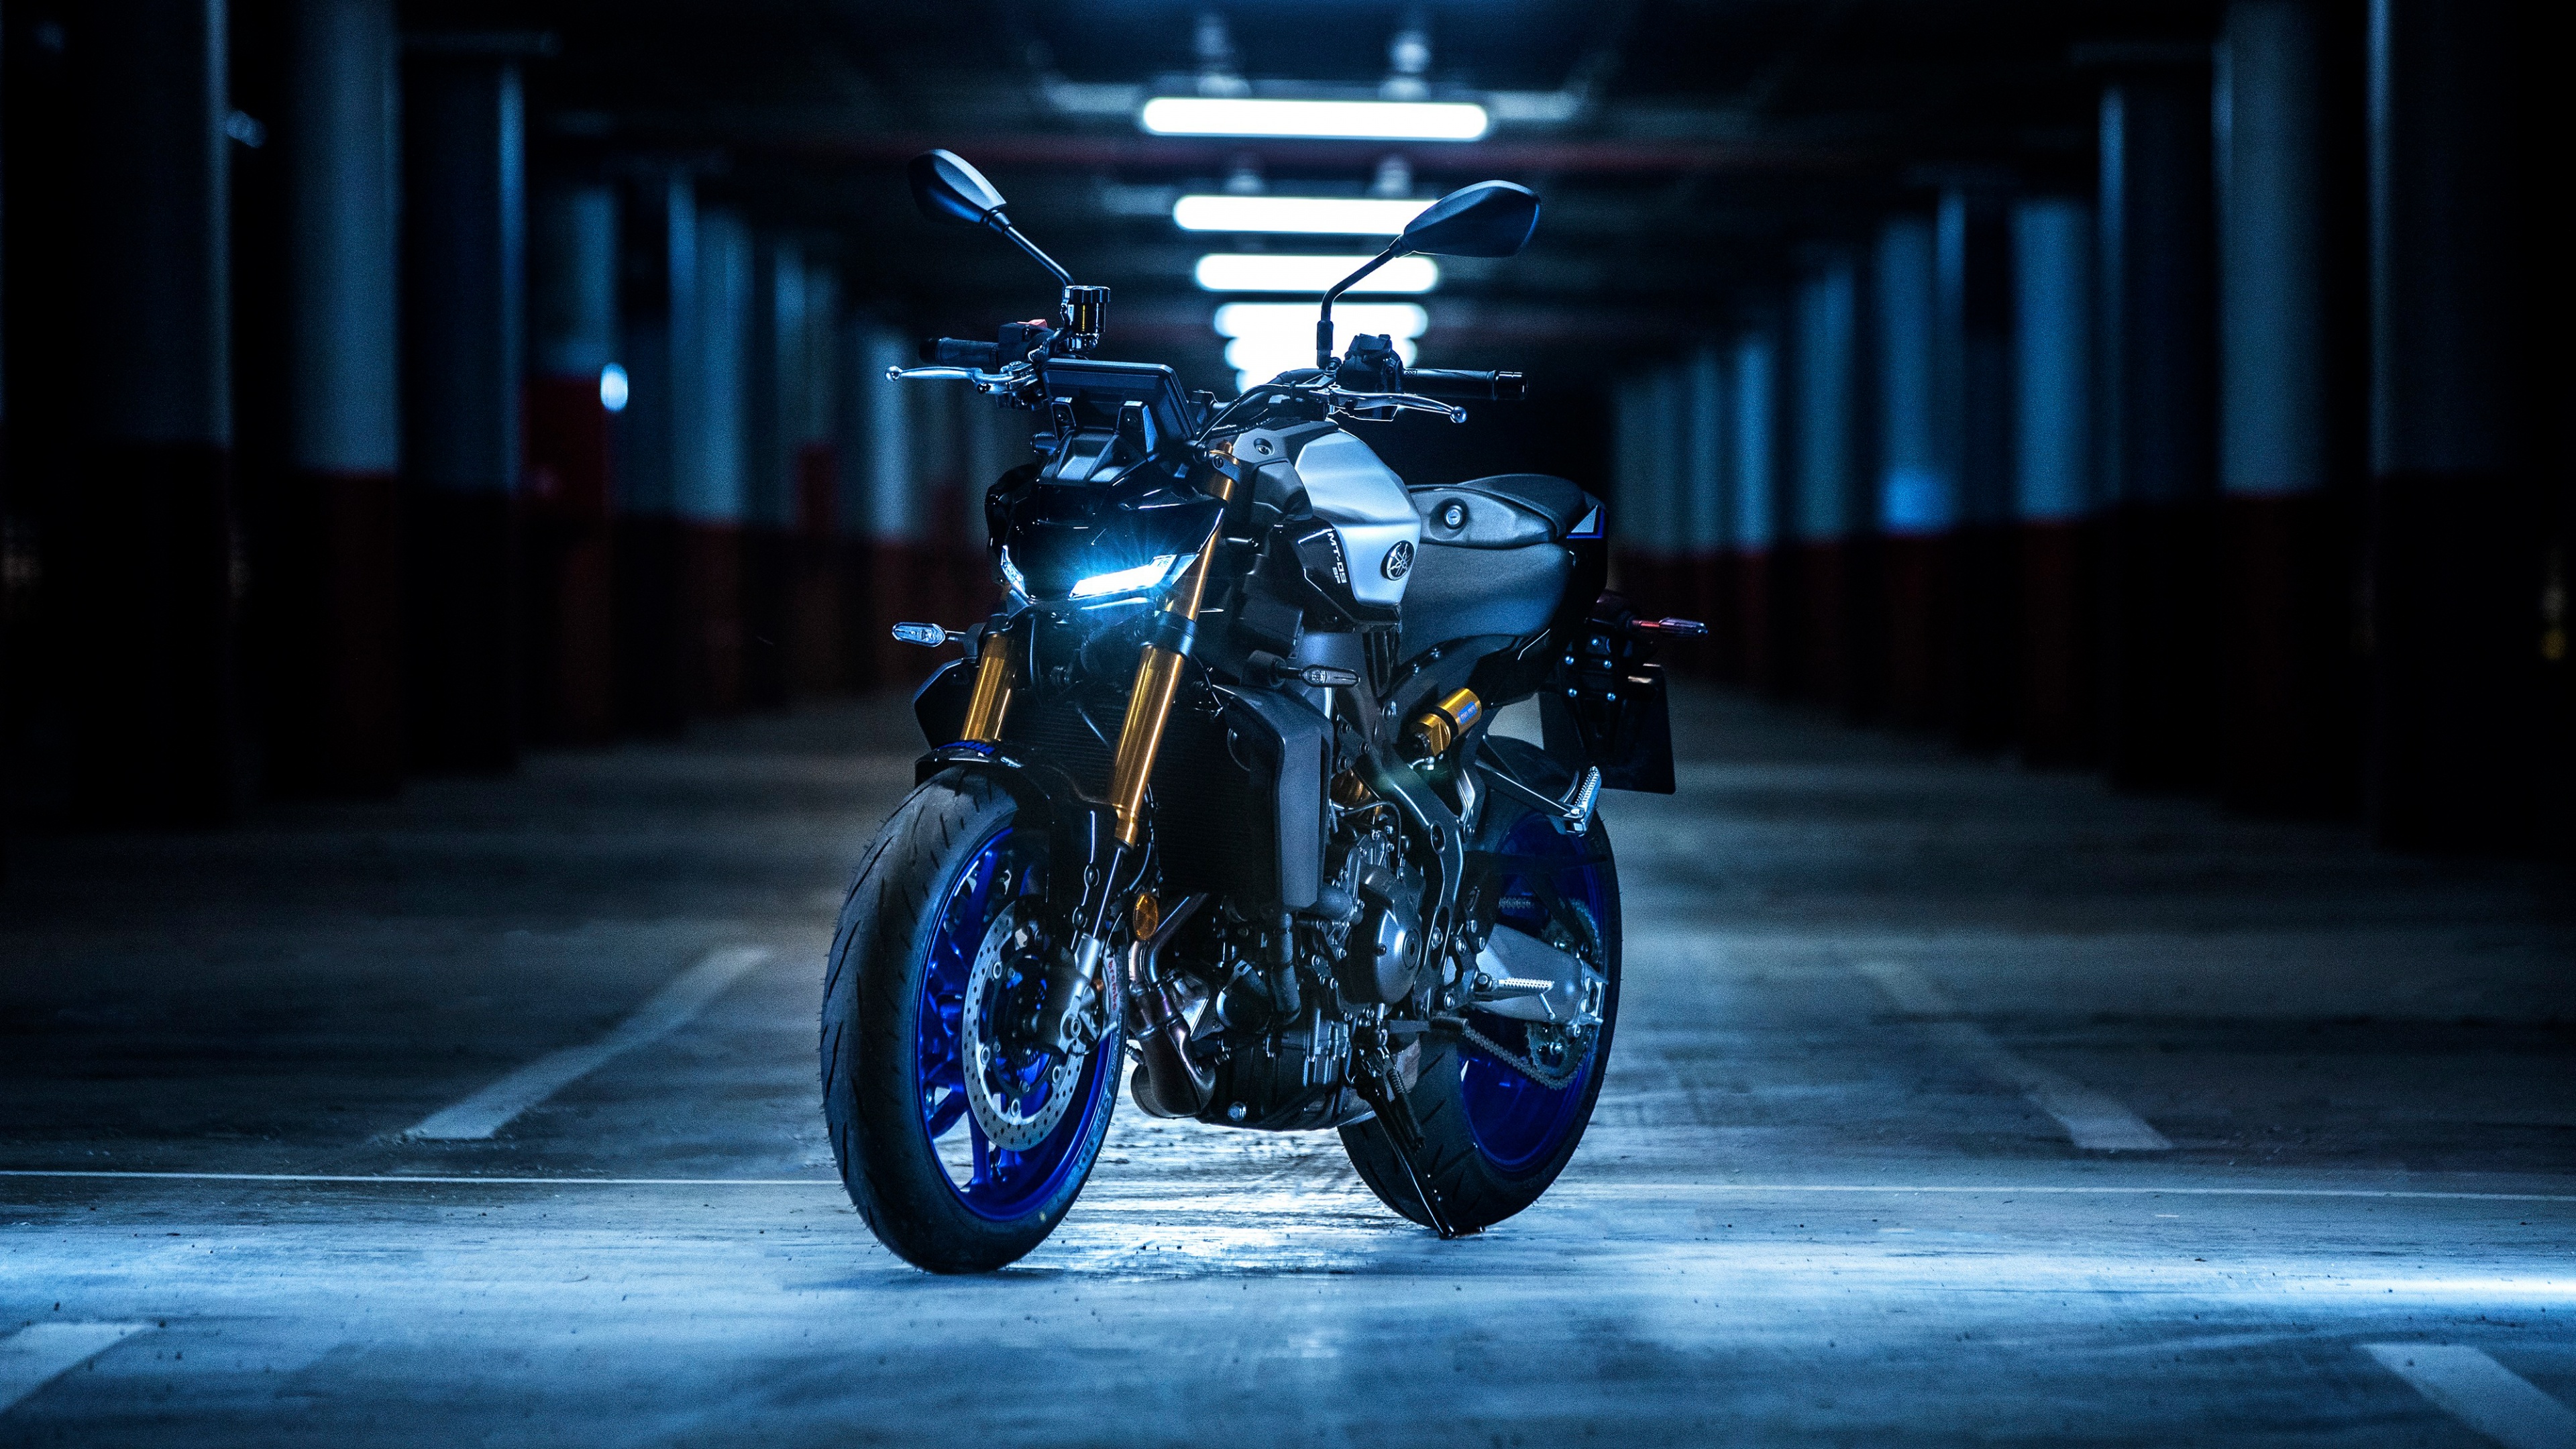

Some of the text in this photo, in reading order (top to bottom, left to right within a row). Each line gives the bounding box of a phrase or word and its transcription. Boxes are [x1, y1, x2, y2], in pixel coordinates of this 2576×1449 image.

[1327, 533, 1347, 584] MT-09
[1332, 567, 1341, 584] SP
[938, 741, 996, 756] AHA
[1108, 960, 1118, 1011] brembo
